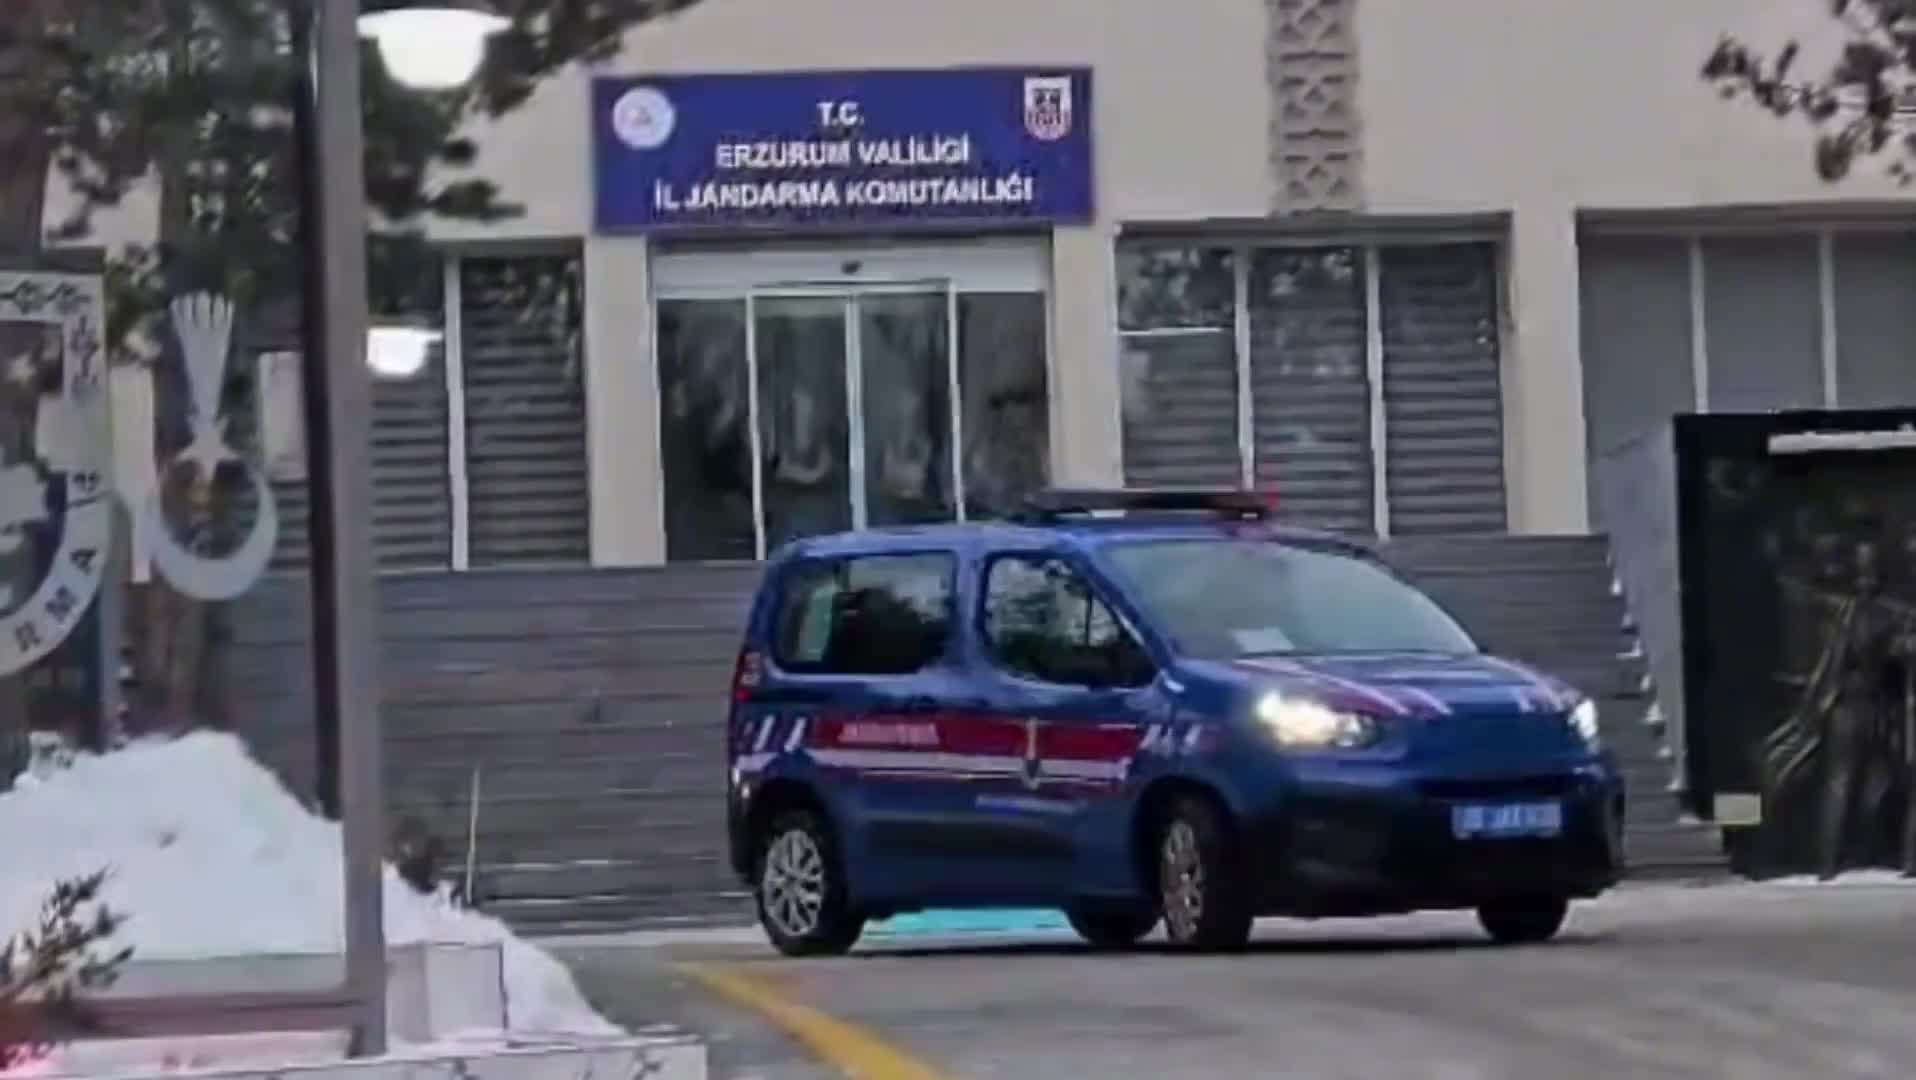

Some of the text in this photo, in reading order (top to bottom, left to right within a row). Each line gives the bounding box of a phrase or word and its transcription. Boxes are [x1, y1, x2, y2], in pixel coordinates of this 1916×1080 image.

[816, 102, 864, 126] T.C.
[715, 141, 850, 168] ERZURUM
[684, 180, 841, 208] JANDARMA
[846, 172, 1033, 204] KOMUTANLIĞI
